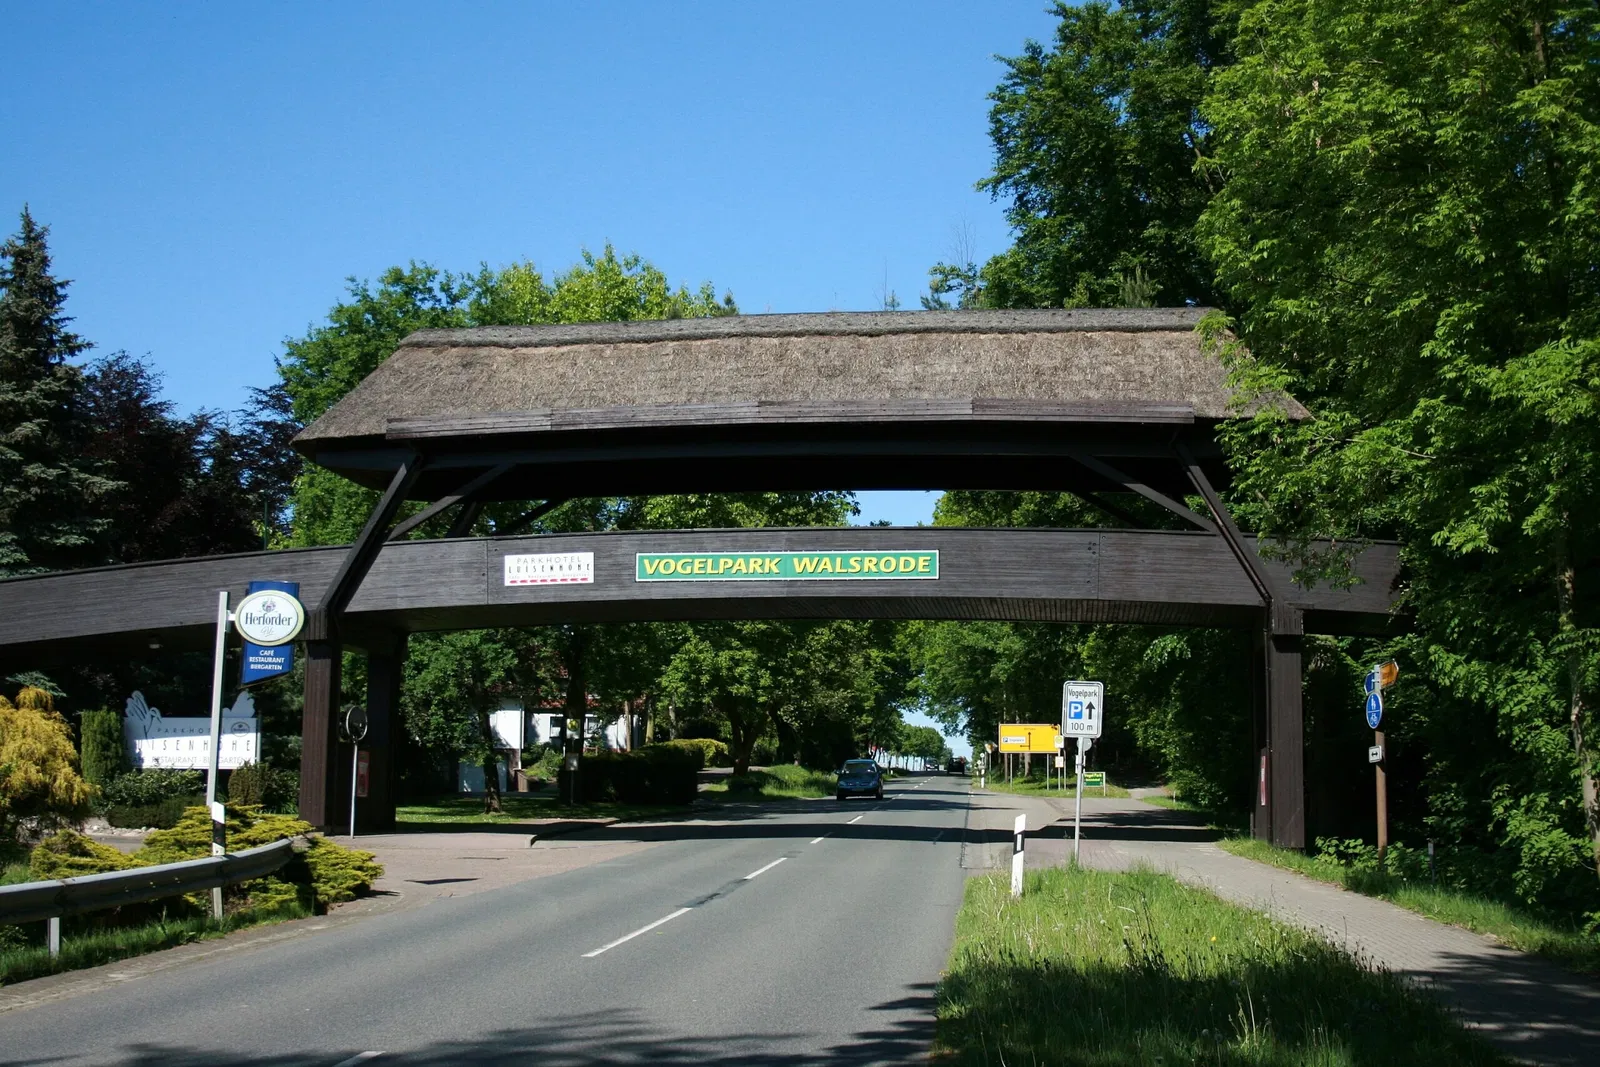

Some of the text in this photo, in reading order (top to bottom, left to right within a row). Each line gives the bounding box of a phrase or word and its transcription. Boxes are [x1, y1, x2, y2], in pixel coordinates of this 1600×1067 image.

[516, 556, 582, 564] PARKHOTEL
[643, 556, 931, 575] VOGELPARK WALSRODE
[244, 612, 293, 626] Herforder
[249, 656, 285, 664] RESTAURANT
[1068, 689, 1098, 699] Vogelpark
[1070, 703, 1082, 718] P
[1070, 722, 1085, 731] 100
